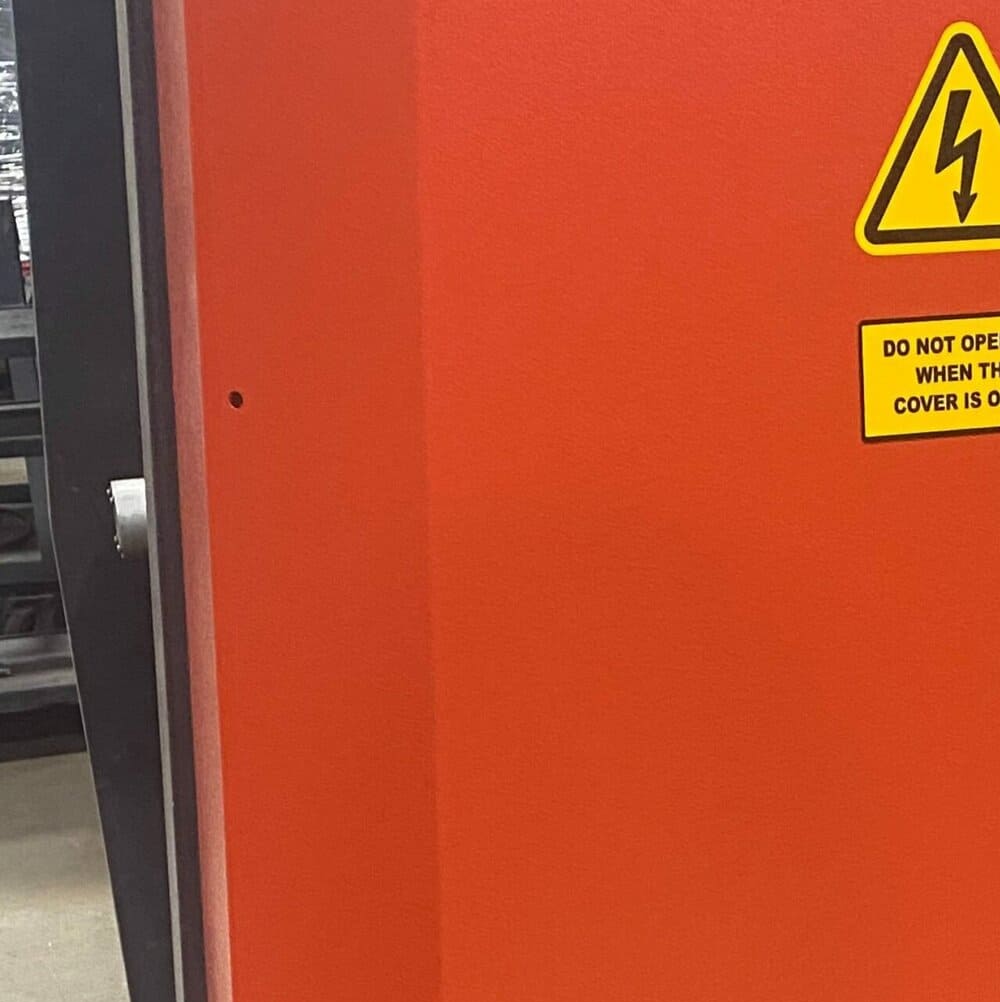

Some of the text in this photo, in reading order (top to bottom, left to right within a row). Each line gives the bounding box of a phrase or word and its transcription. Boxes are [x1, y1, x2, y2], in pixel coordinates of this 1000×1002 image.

[883, 339, 910, 357] DO
[916, 336, 955, 355] NOT
[916, 363, 972, 384] WHEN
[894, 393, 958, 414] COVER
[964, 391, 982, 409] IS
